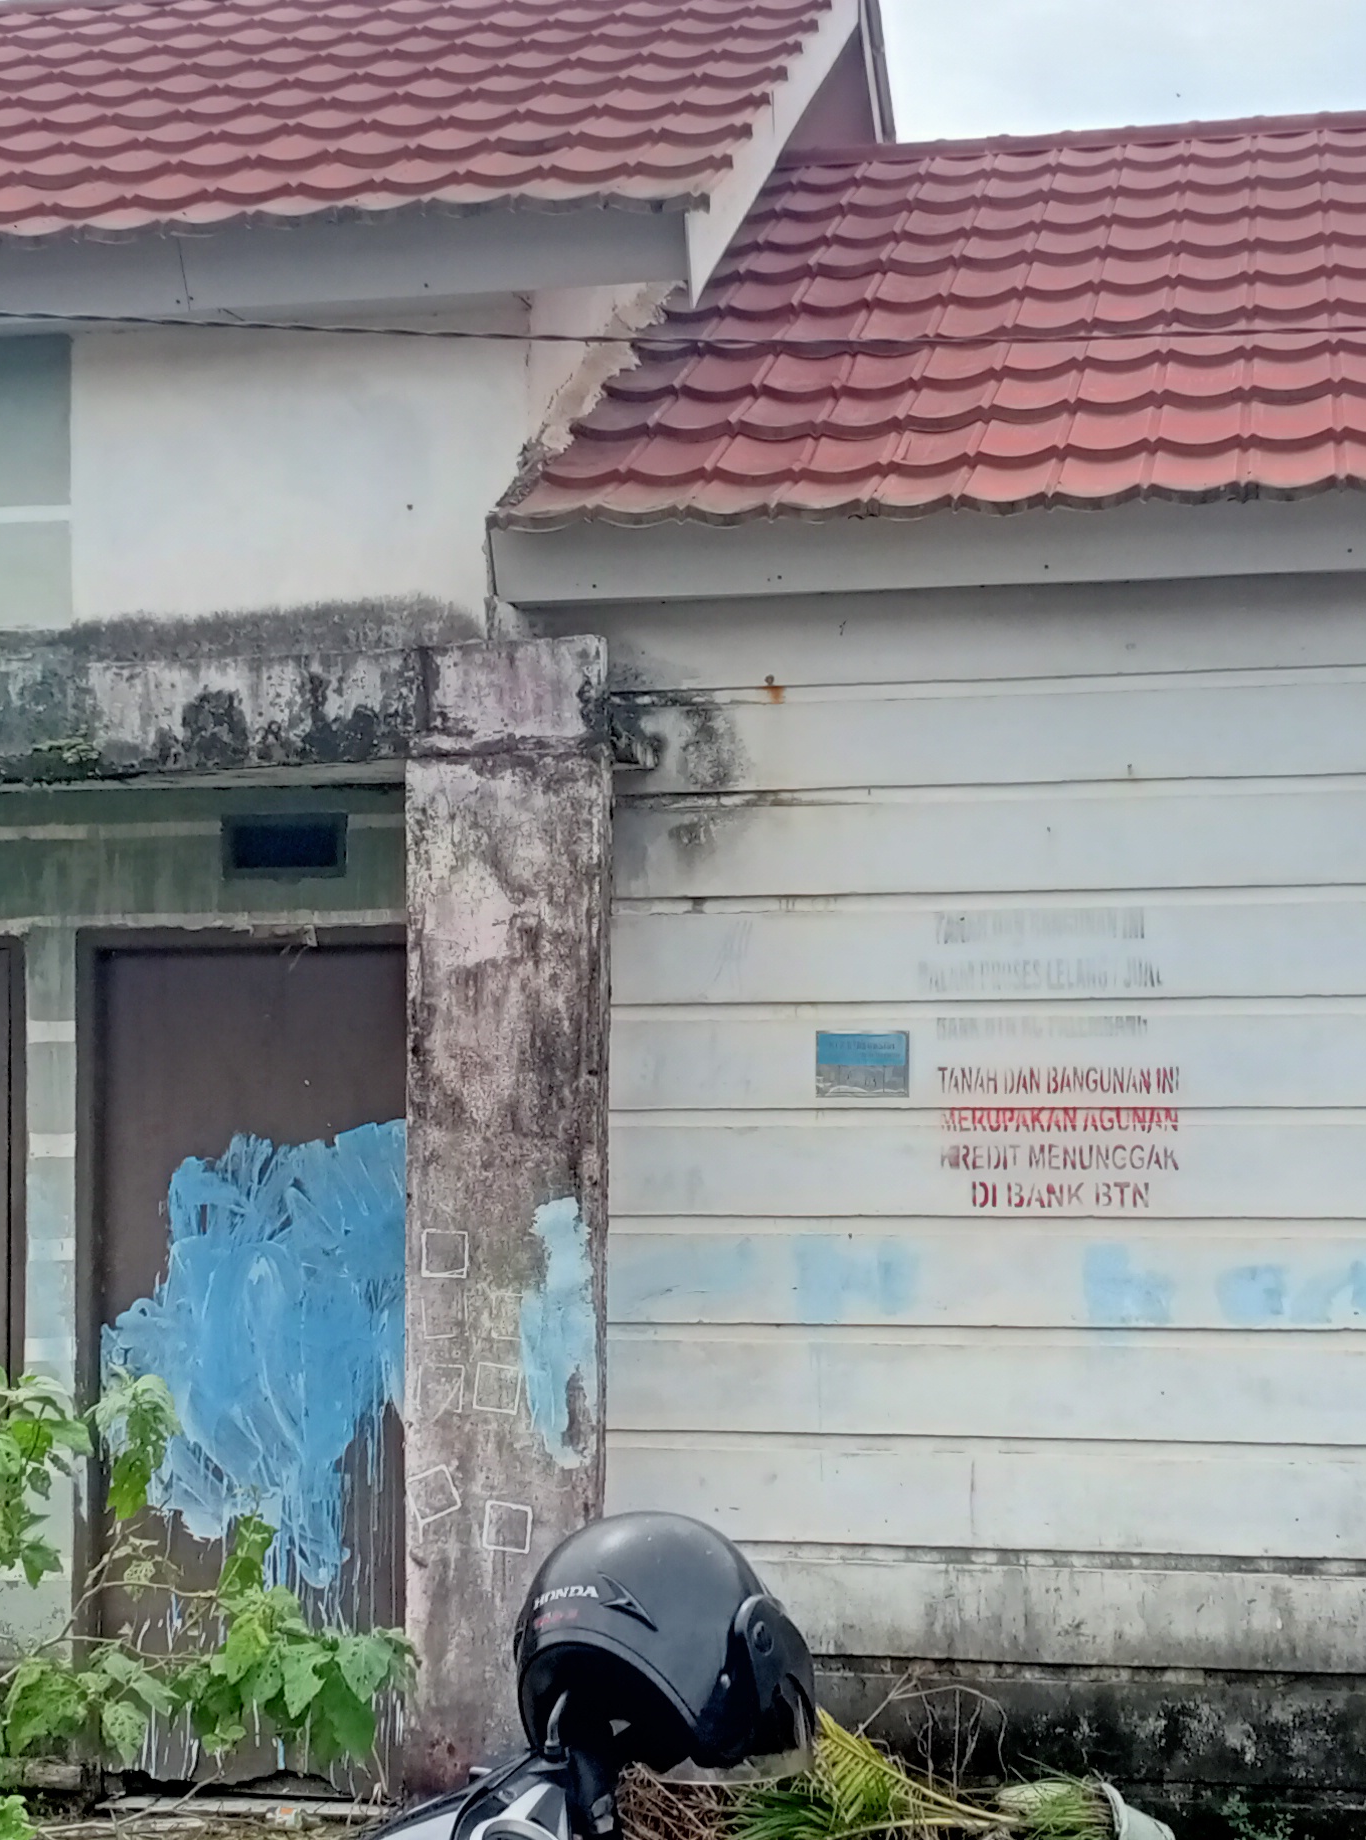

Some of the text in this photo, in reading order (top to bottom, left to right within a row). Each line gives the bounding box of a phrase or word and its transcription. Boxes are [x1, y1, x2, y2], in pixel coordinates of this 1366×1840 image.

[937, 1066, 1180, 1095] TANAH DAN BANGUNAN INI
[941, 1106, 1179, 1133] MERUPAKAN AGUNAN
[940, 1143, 1180, 1171] KREDIT MENUNGGAK
[971, 1181, 1150, 1209] DI BANK BTN
[533, 1585, 599, 1611] HONDA
